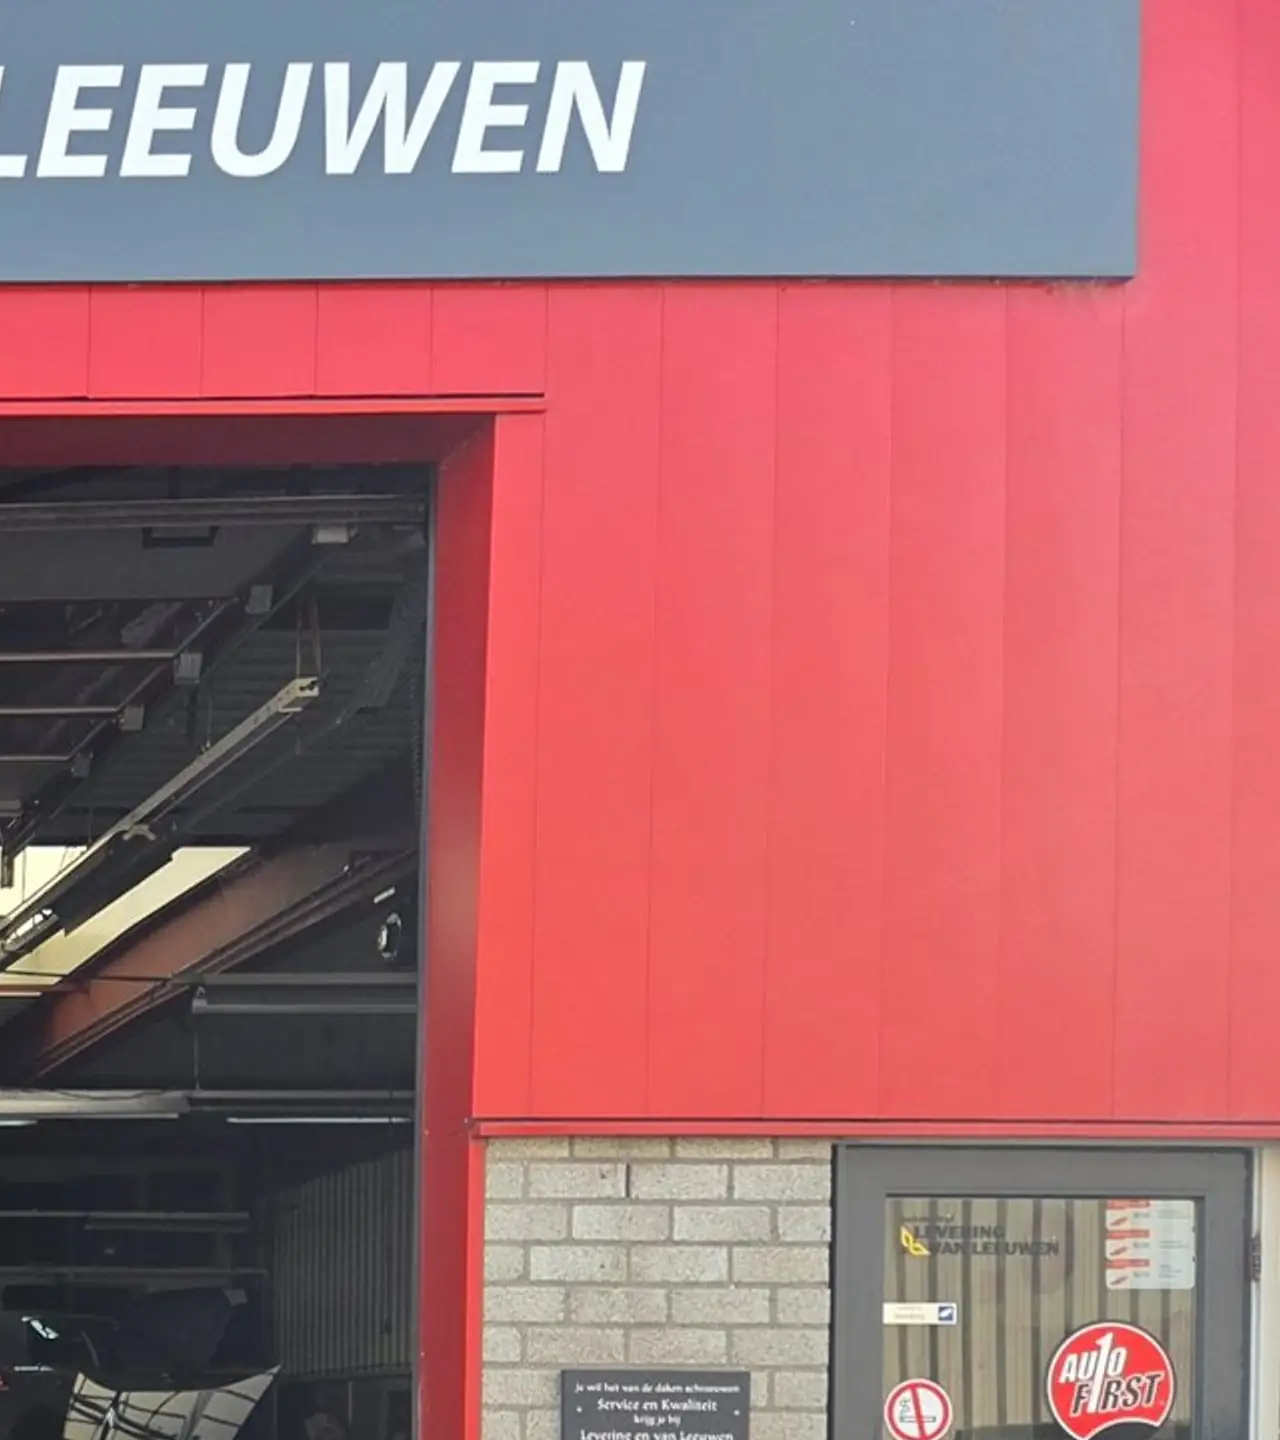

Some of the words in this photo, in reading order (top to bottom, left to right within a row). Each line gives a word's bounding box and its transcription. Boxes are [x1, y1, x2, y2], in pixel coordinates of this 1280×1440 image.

[597, 1397, 639, 1411] Service
[642, 1400, 658, 1411] en
[661, 1398, 718, 1411] Kwaliteit
[1069, 1370, 1165, 1418] FIRST
